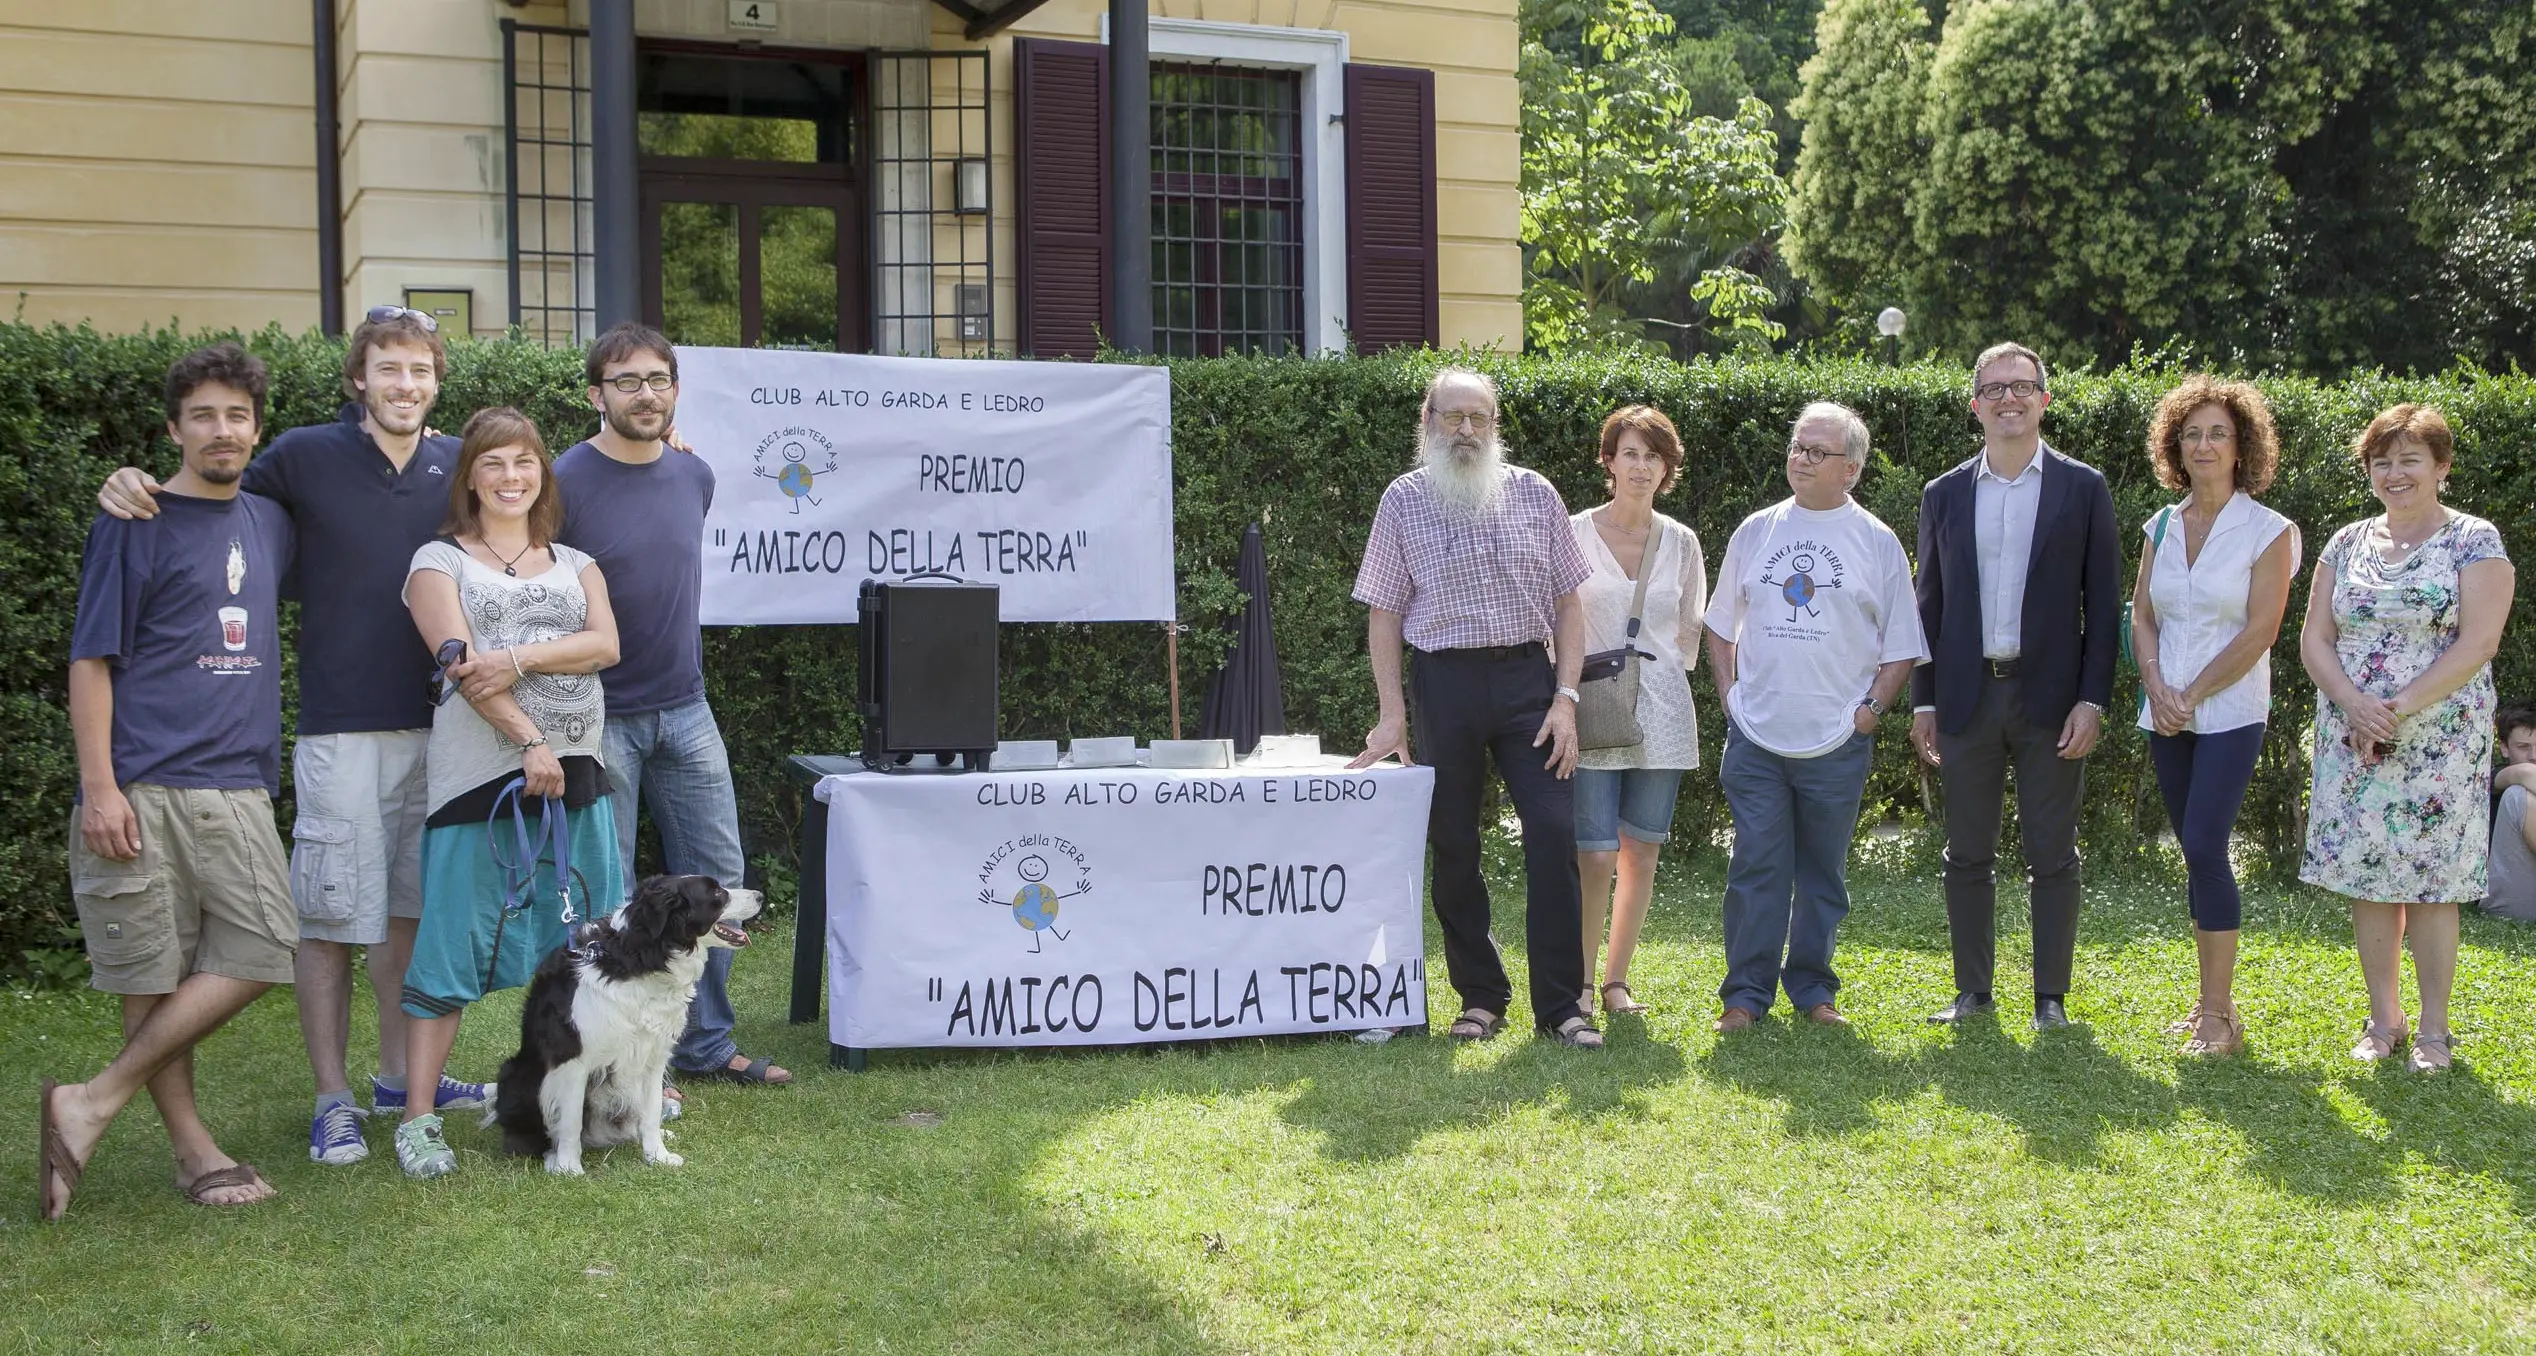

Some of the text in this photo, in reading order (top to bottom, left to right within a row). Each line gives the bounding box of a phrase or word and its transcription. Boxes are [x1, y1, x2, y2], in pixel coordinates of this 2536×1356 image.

[745, 4, 760, 20] 4
[750, 387, 1044, 413] CLUB ALTO GARDA E LEDRO
[753, 425, 838, 462] AMICI della TERRA
[919, 454, 1025, 494] PREMIO
[715, 528, 1088, 575] "AMICO DELLA TERRA"
[1764, 540, 1844, 577] AMICI della TERRA
[977, 778, 1377, 807] CLUB ALTO GARDA E LEDRO
[978, 832, 1092, 885] AMICI della TERRA
[1202, 862, 1346, 917] PREMIO
[928, 957, 1423, 1037] "AMICO DELLA TERRA"
